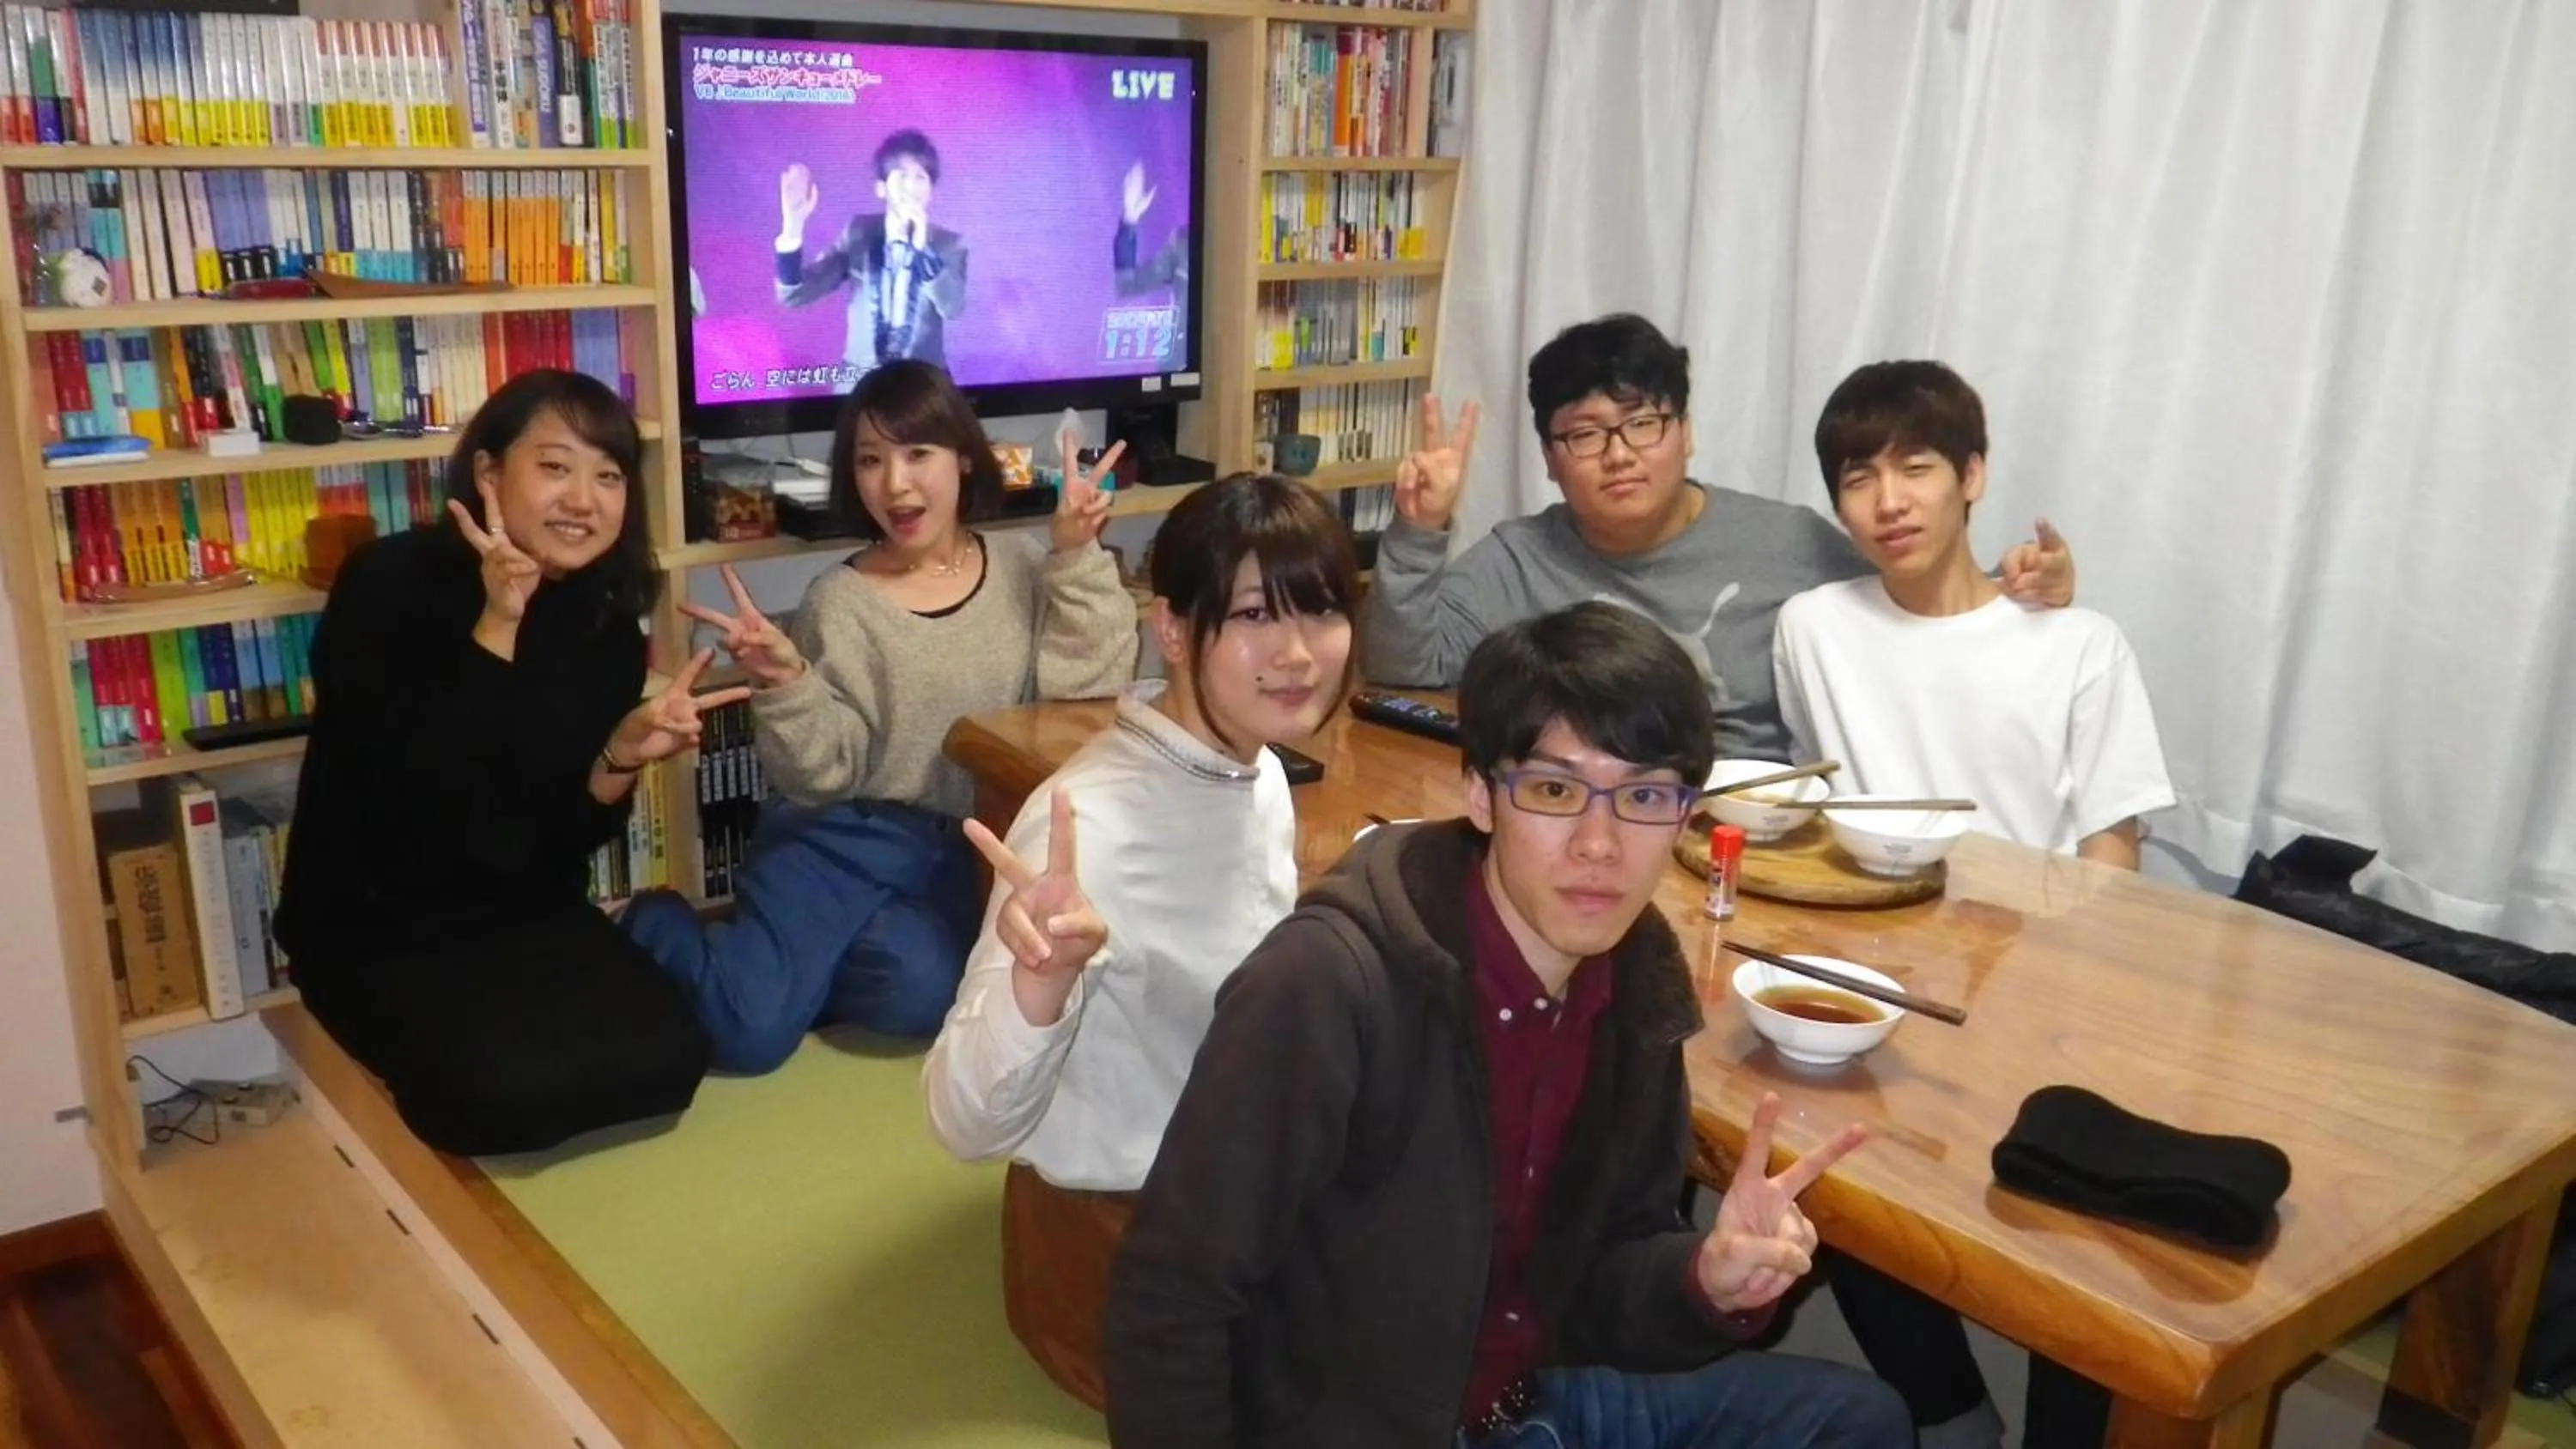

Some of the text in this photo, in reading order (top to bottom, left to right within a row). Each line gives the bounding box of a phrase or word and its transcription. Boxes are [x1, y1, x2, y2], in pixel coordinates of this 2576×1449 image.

[1111, 69, 1175, 100] LIVE
[710, 370, 756, 390] ごらん
